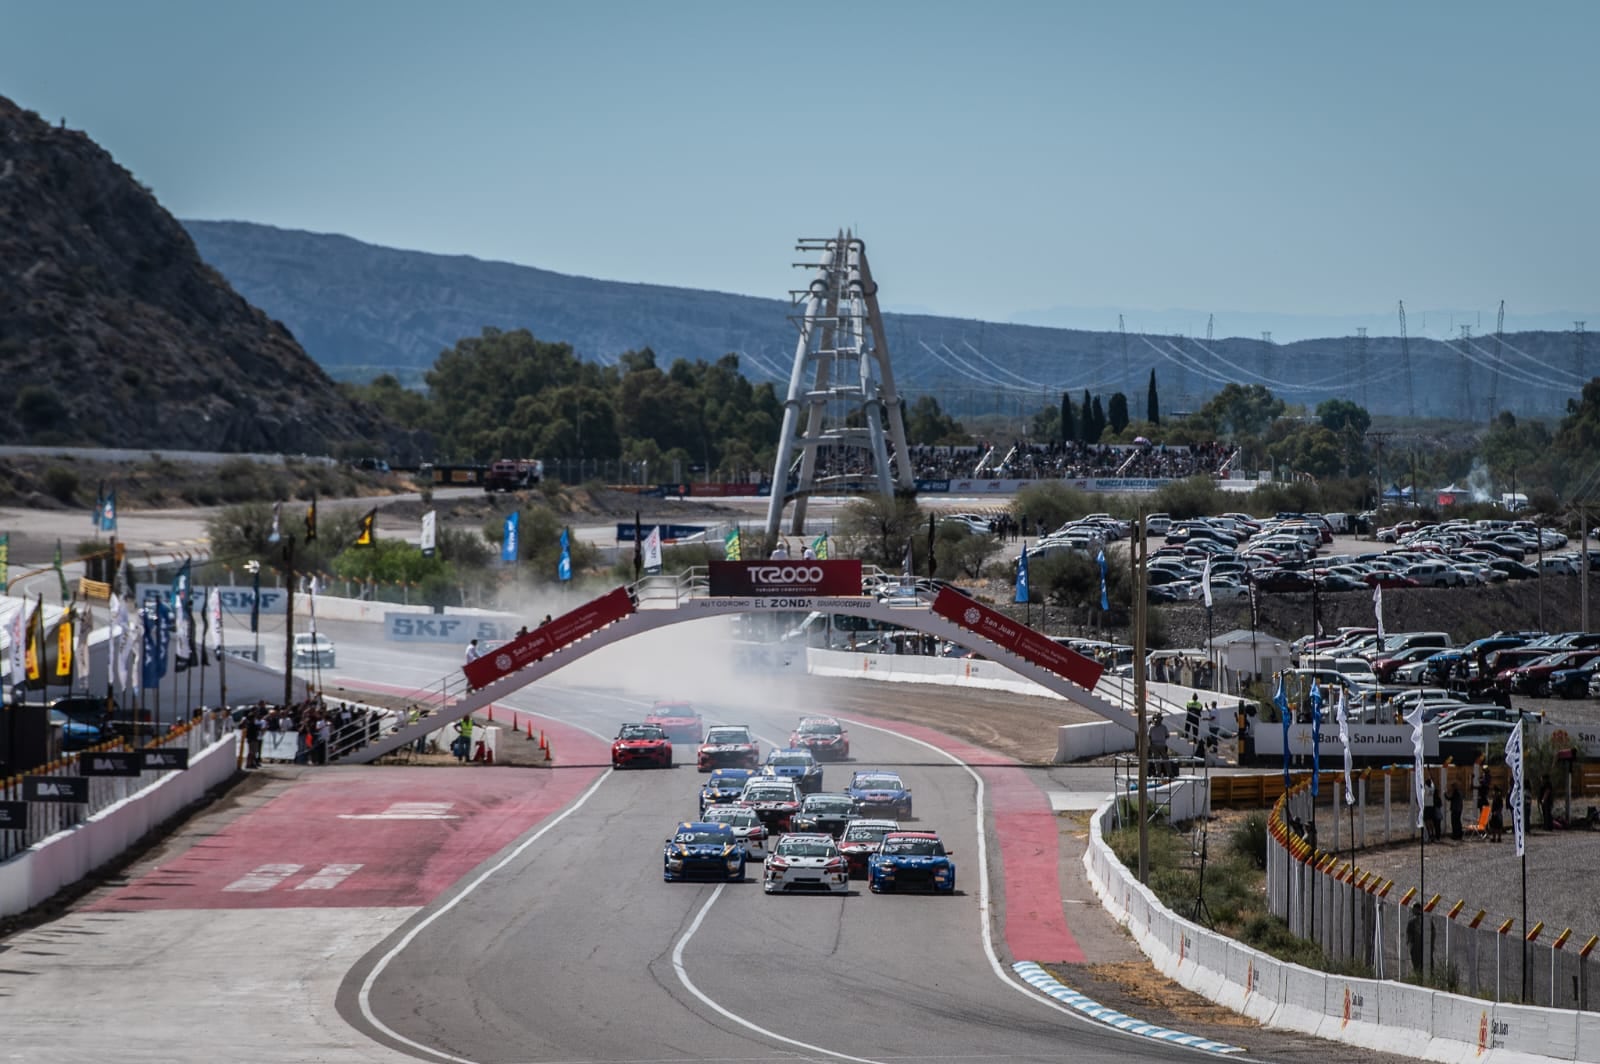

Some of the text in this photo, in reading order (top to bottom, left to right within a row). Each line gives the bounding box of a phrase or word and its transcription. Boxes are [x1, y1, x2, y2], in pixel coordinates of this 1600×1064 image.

[748, 566, 824, 583] TC2000
[222, 591, 280, 609] SKF
[754, 600, 767, 608] EL
[392, 618, 460, 636] SKF
[983, 616, 998, 629] San
[999, 622, 1016, 637] Juan
[1318, 732, 1402, 745] Ban San Juan
[1578, 732, 1596, 744] San
[37, 783, 60, 796] BA
[676, 833, 694, 842] 30
[849, 832, 873, 840] 162
